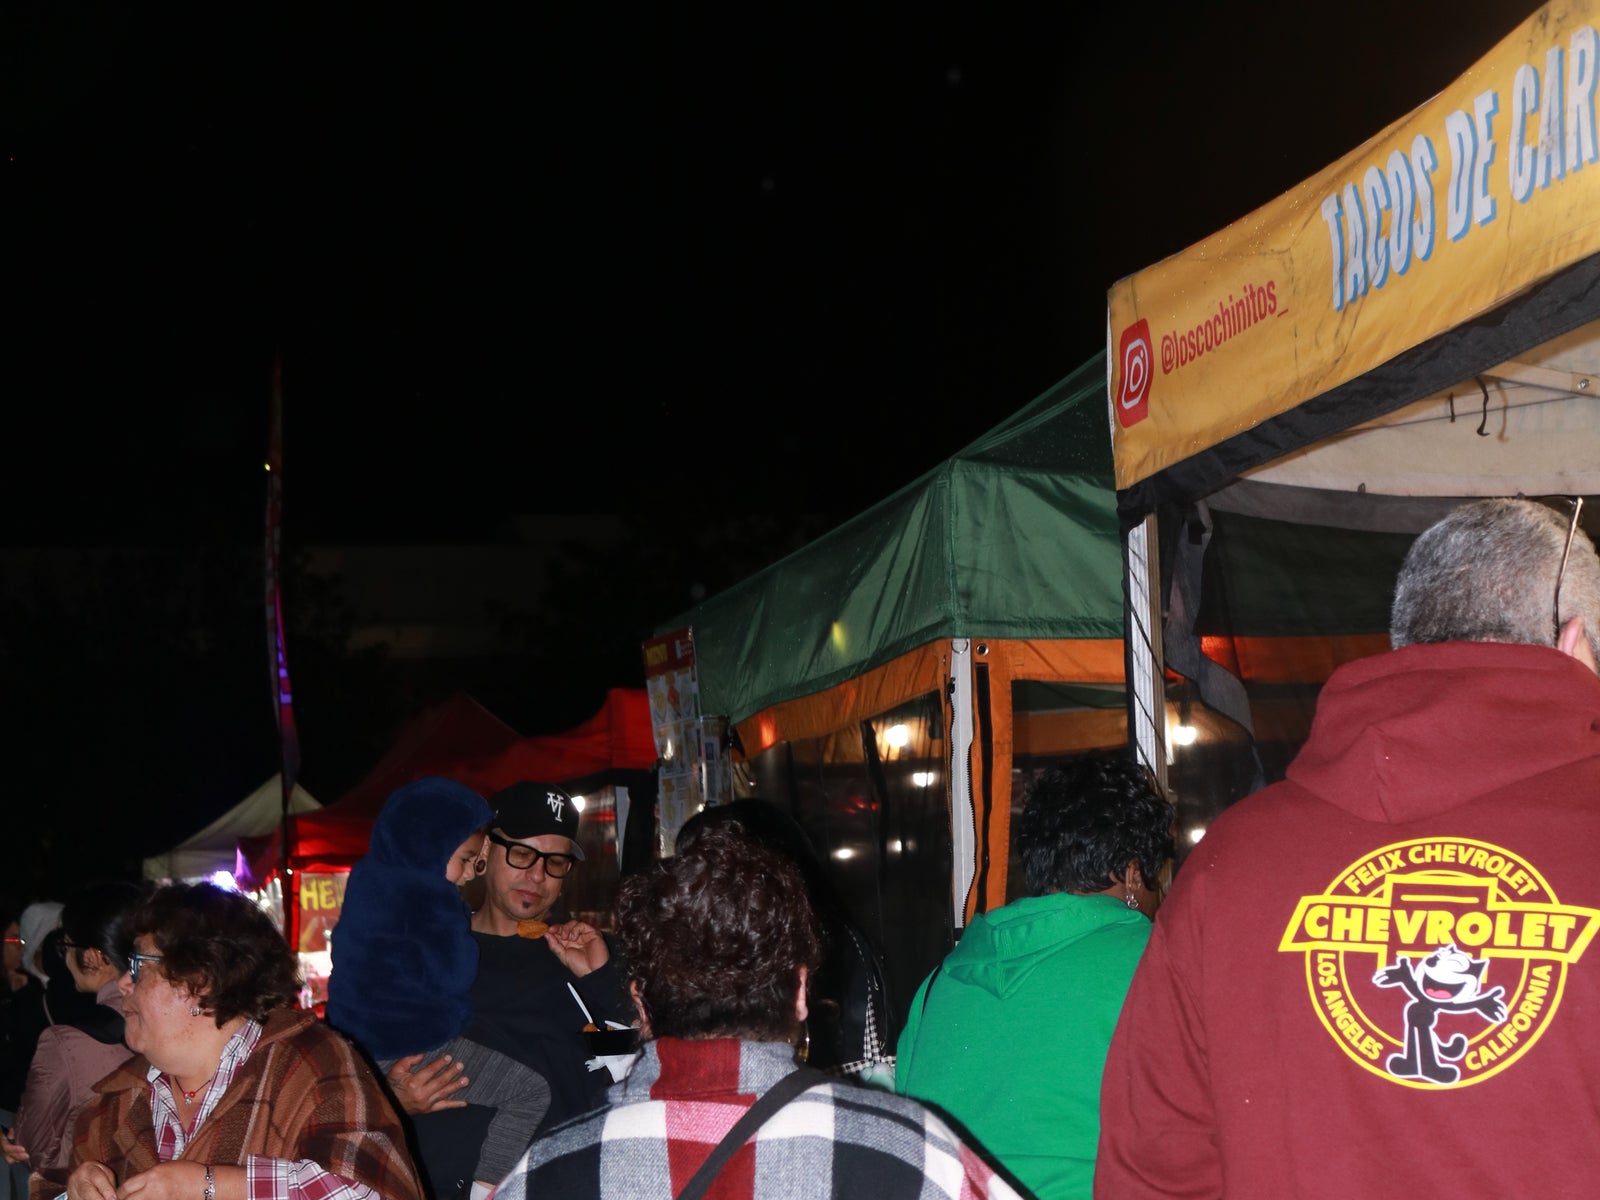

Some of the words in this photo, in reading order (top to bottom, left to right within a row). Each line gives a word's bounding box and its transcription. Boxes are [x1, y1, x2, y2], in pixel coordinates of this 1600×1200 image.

[1321, 133, 1438, 312] TACOS
[1445, 89, 1499, 243] DE
[1509, 24, 1600, 204] CAR
[1161, 279, 1289, 376] @loscochinitos_
[1344, 850, 1405, 894] FELIX
[1408, 844, 1539, 897] CHEVROLET
[1304, 905, 1576, 950] CHEVROLET
[1317, 953, 1338, 988] LOS
[1322, 990, 1384, 1061] ANGELES
[1465, 965, 1553, 1071] CALIFORNIA
